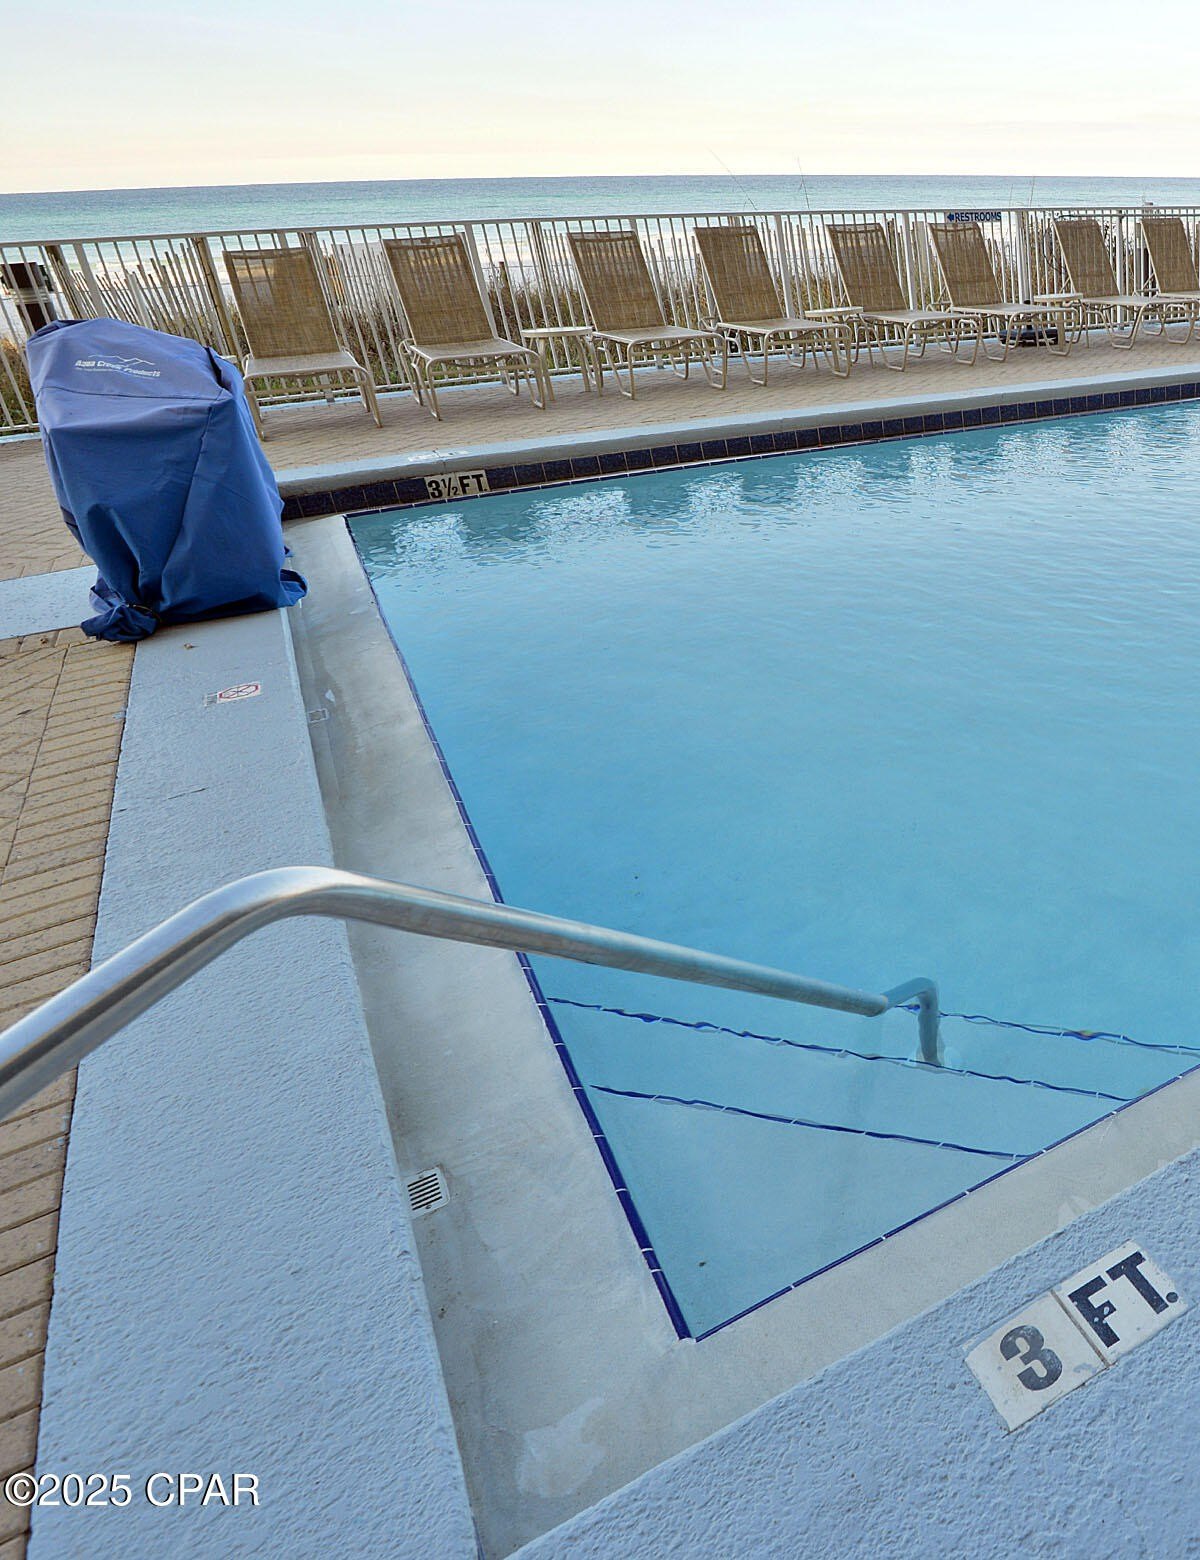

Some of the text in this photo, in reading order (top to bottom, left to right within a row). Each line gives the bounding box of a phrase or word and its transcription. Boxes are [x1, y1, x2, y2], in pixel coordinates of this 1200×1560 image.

[954, 211, 1002, 222] RESTROOMS
[999, 1250, 1180, 1391] 3 FT.
